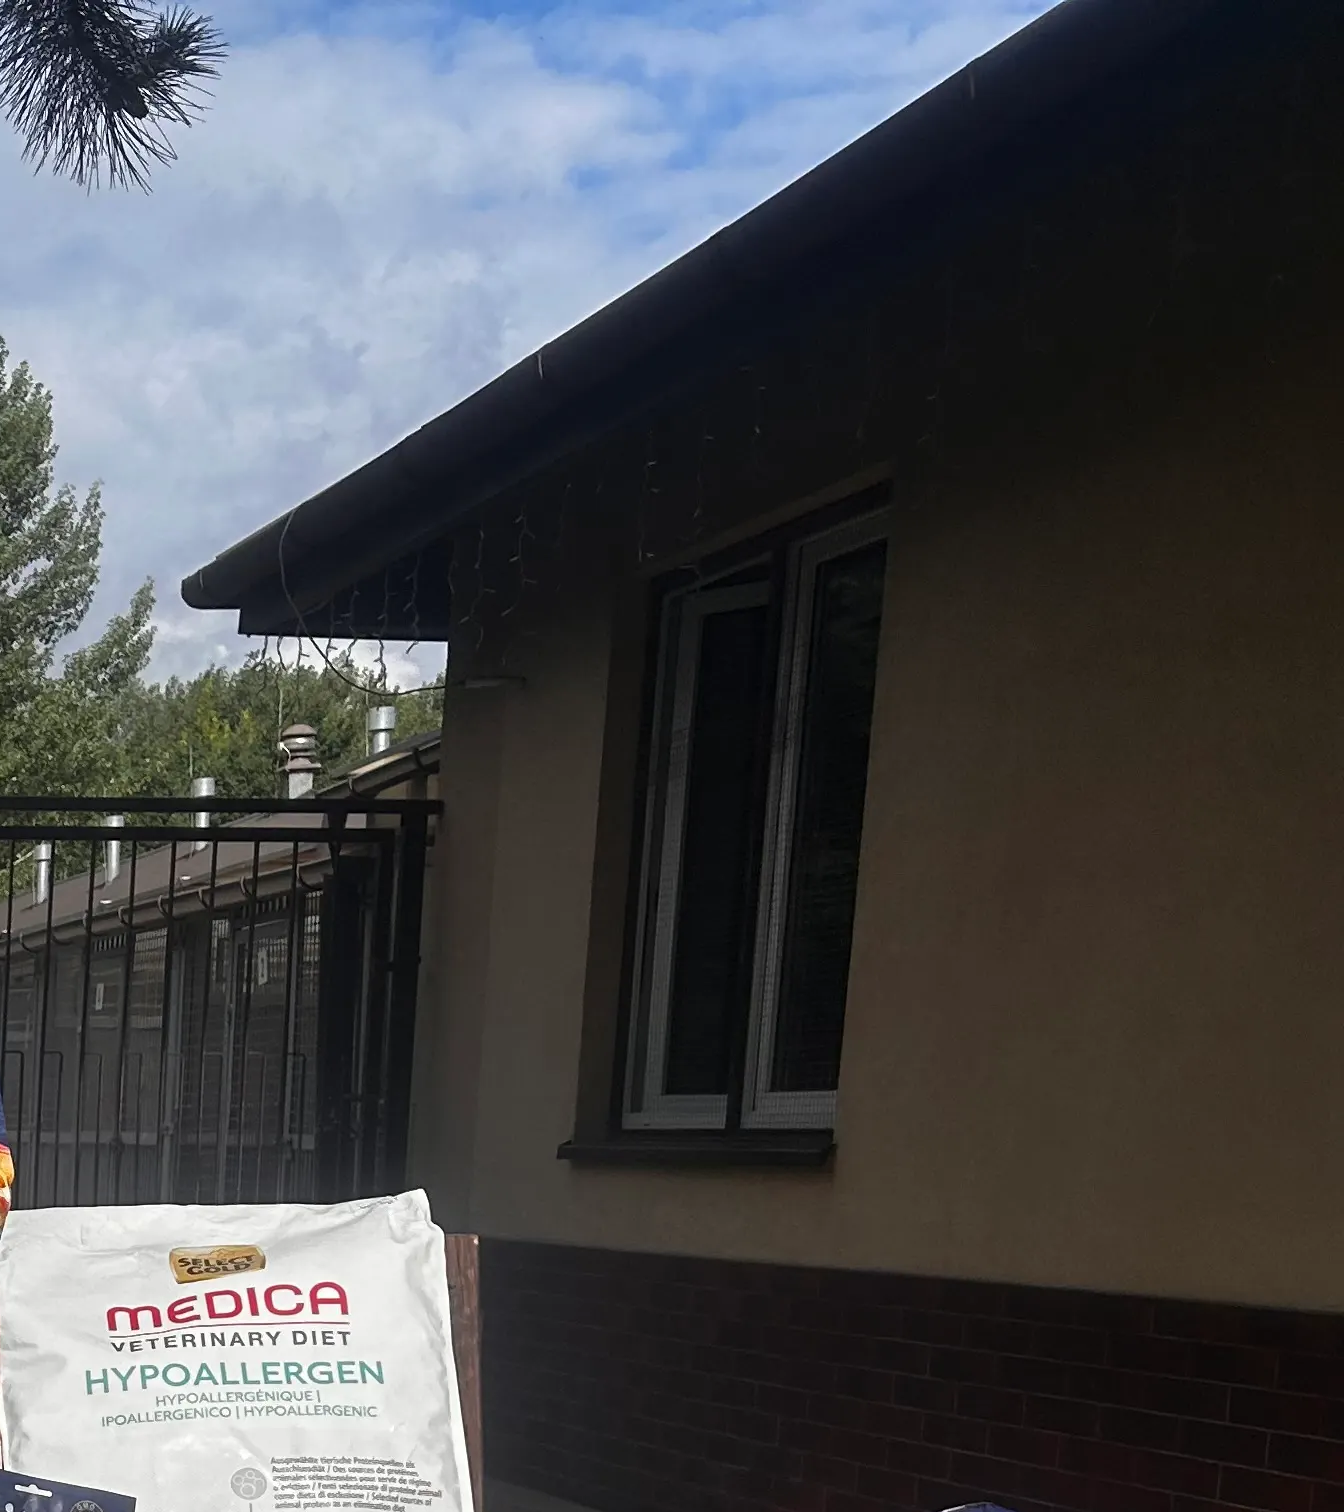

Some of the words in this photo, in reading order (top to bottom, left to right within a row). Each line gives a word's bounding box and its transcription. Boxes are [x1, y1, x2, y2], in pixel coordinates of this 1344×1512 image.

[178, 1254, 253, 1269] SELECT
[186, 1262, 252, 1275] GOLD
[110, 1332, 281, 1353] VETERINARY
[292, 1331, 351, 1347] DIET
[86, 1361, 384, 1395] HYPOALLERGEN
[156, 1389, 312, 1407] HYPOALLERGÉNIQUE
[101, 1406, 231, 1427] IPOALLERGENICO
[244, 1404, 377, 1418] HYPOALLERGENIC
